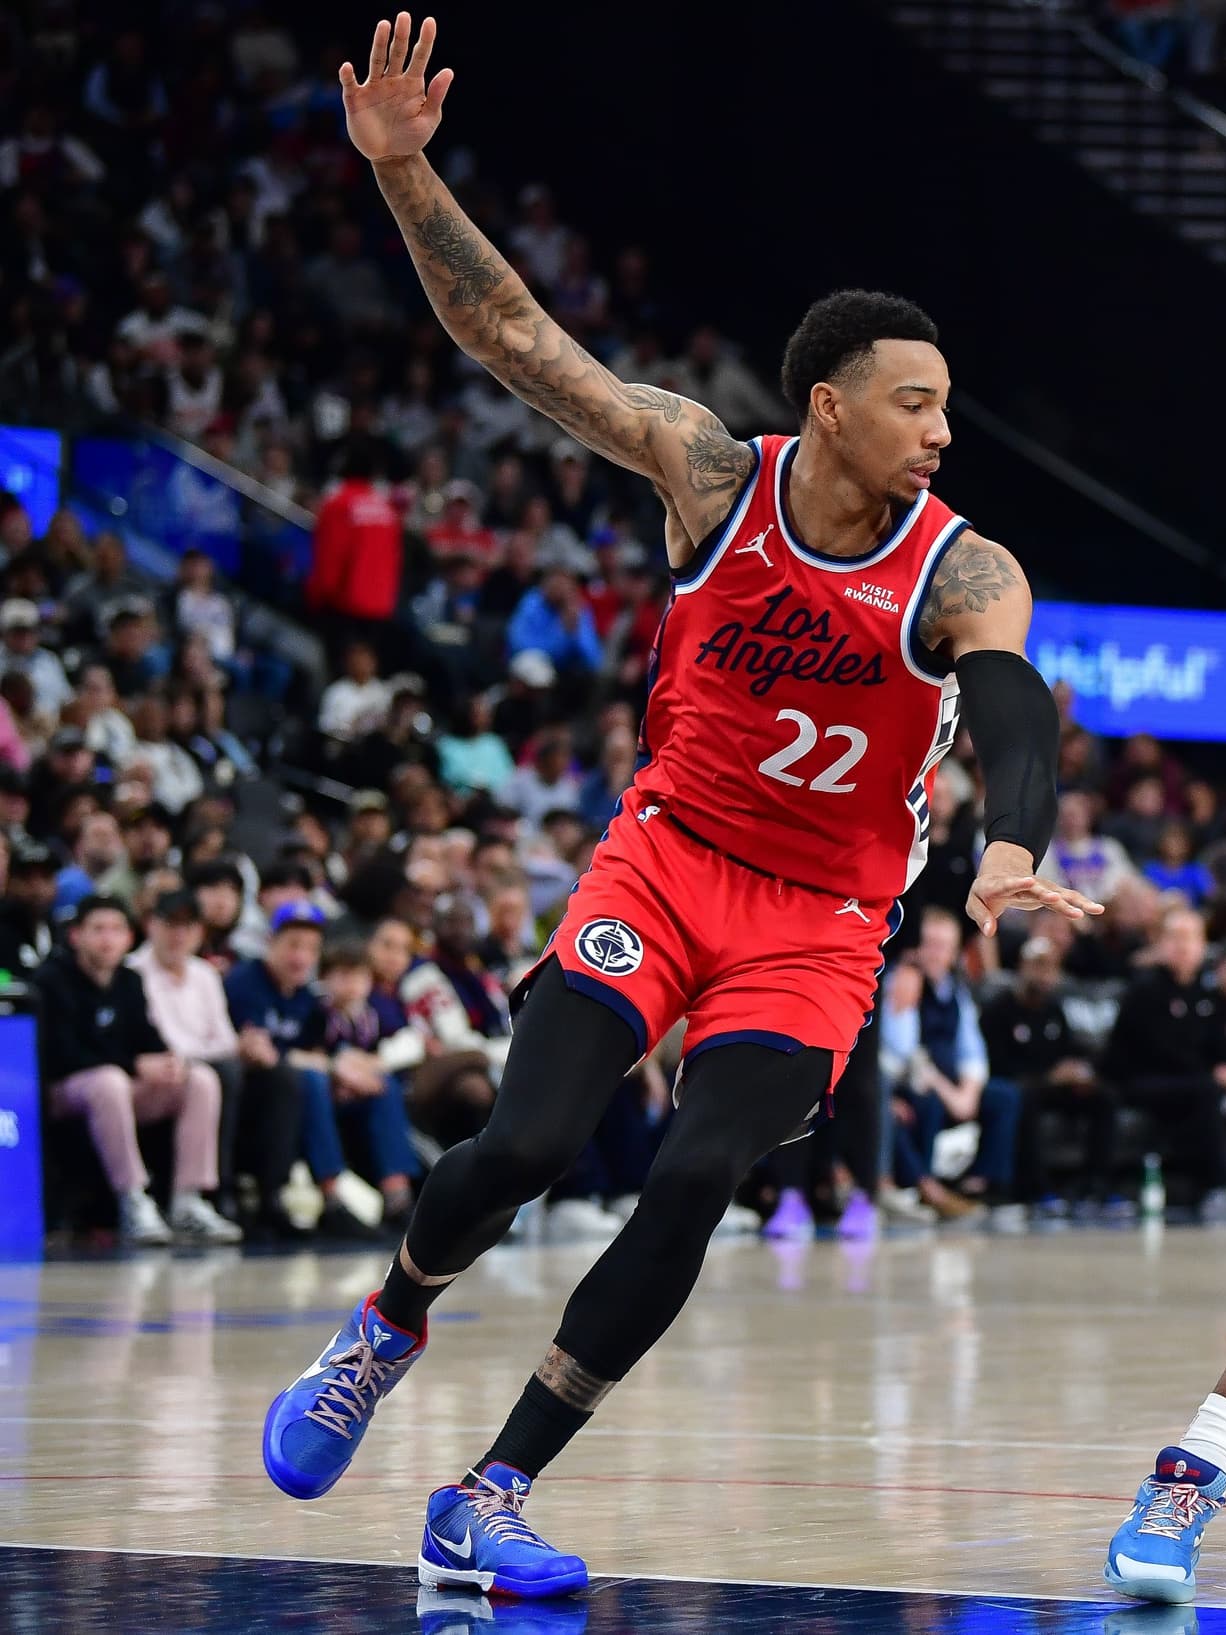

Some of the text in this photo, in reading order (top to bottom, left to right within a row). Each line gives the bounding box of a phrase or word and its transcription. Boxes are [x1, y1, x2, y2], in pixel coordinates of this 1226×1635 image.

[750, 584, 834, 643] Los
[843, 586, 899, 614] RWANDA
[860, 581, 895, 600] VISIT
[694, 621, 888, 697] Angeles
[758, 708, 869, 793] 22
